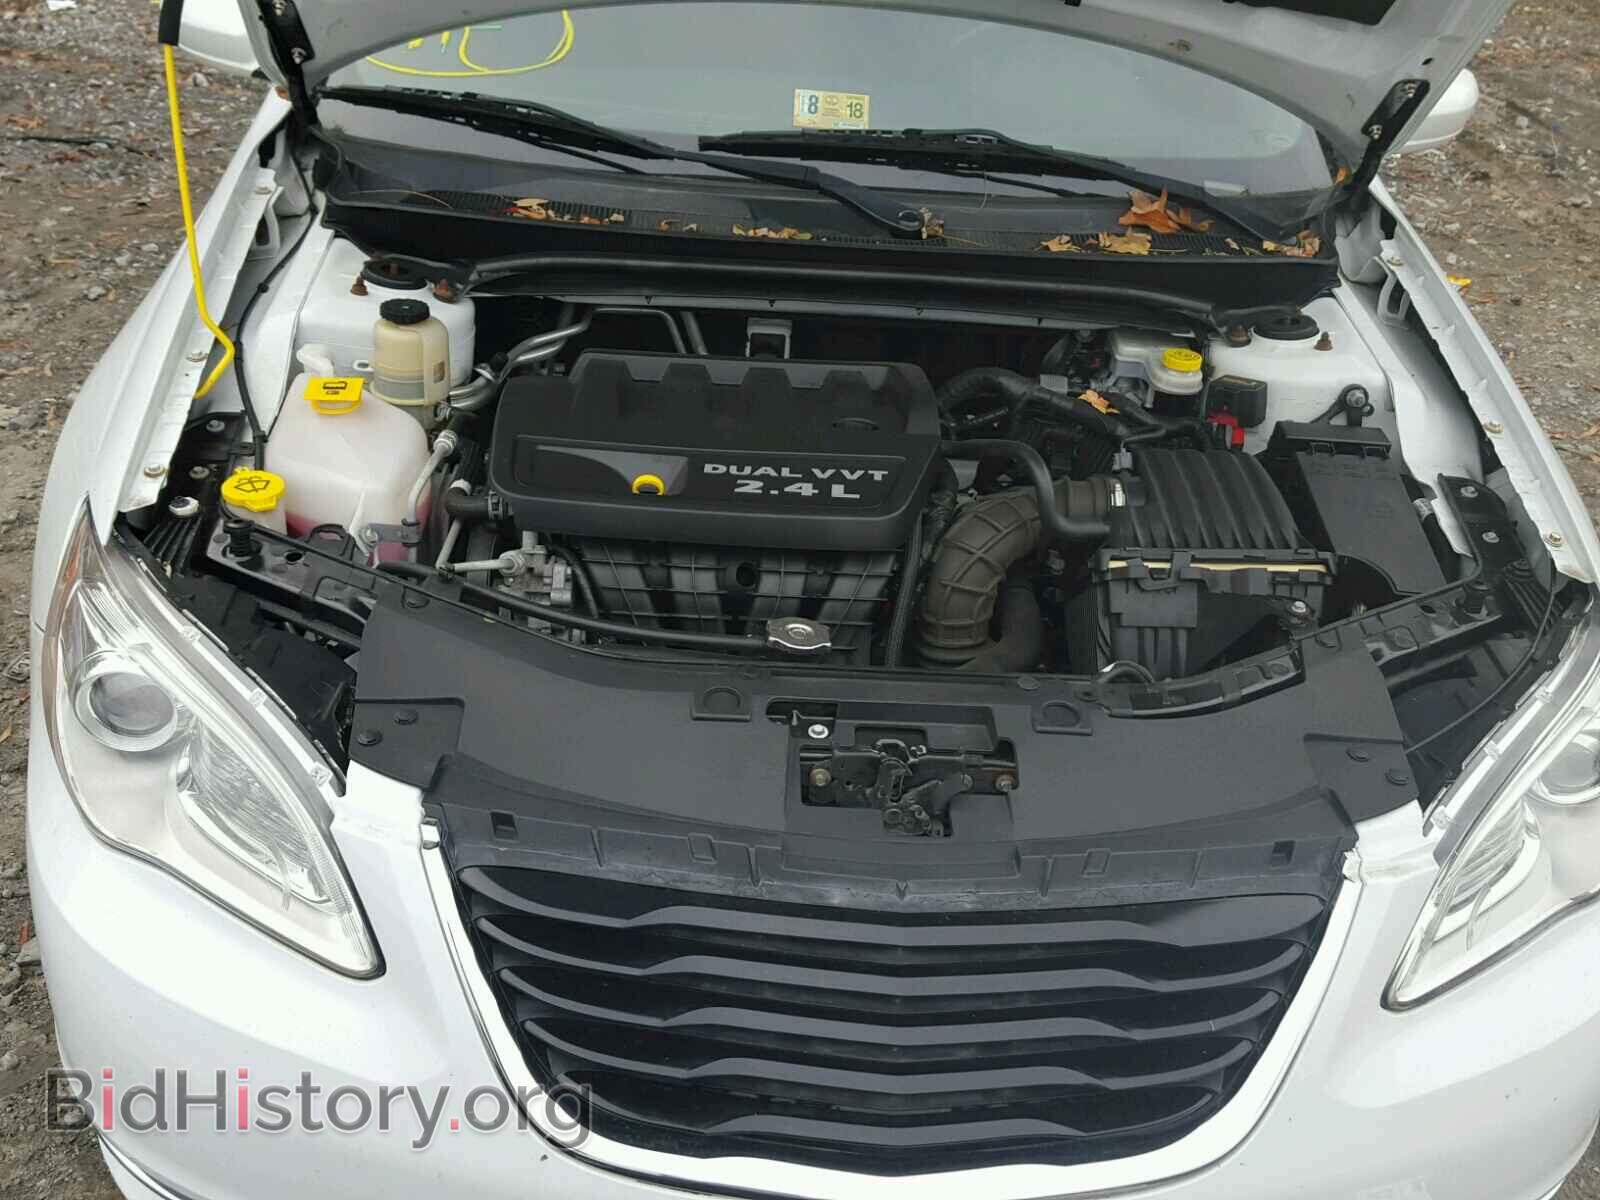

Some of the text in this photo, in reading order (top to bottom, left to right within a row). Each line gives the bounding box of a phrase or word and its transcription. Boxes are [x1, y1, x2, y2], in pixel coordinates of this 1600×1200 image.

[807, 94, 818, 114] 8
[847, 101, 864, 119] 18
[703, 463, 889, 481] DUAL VVT
